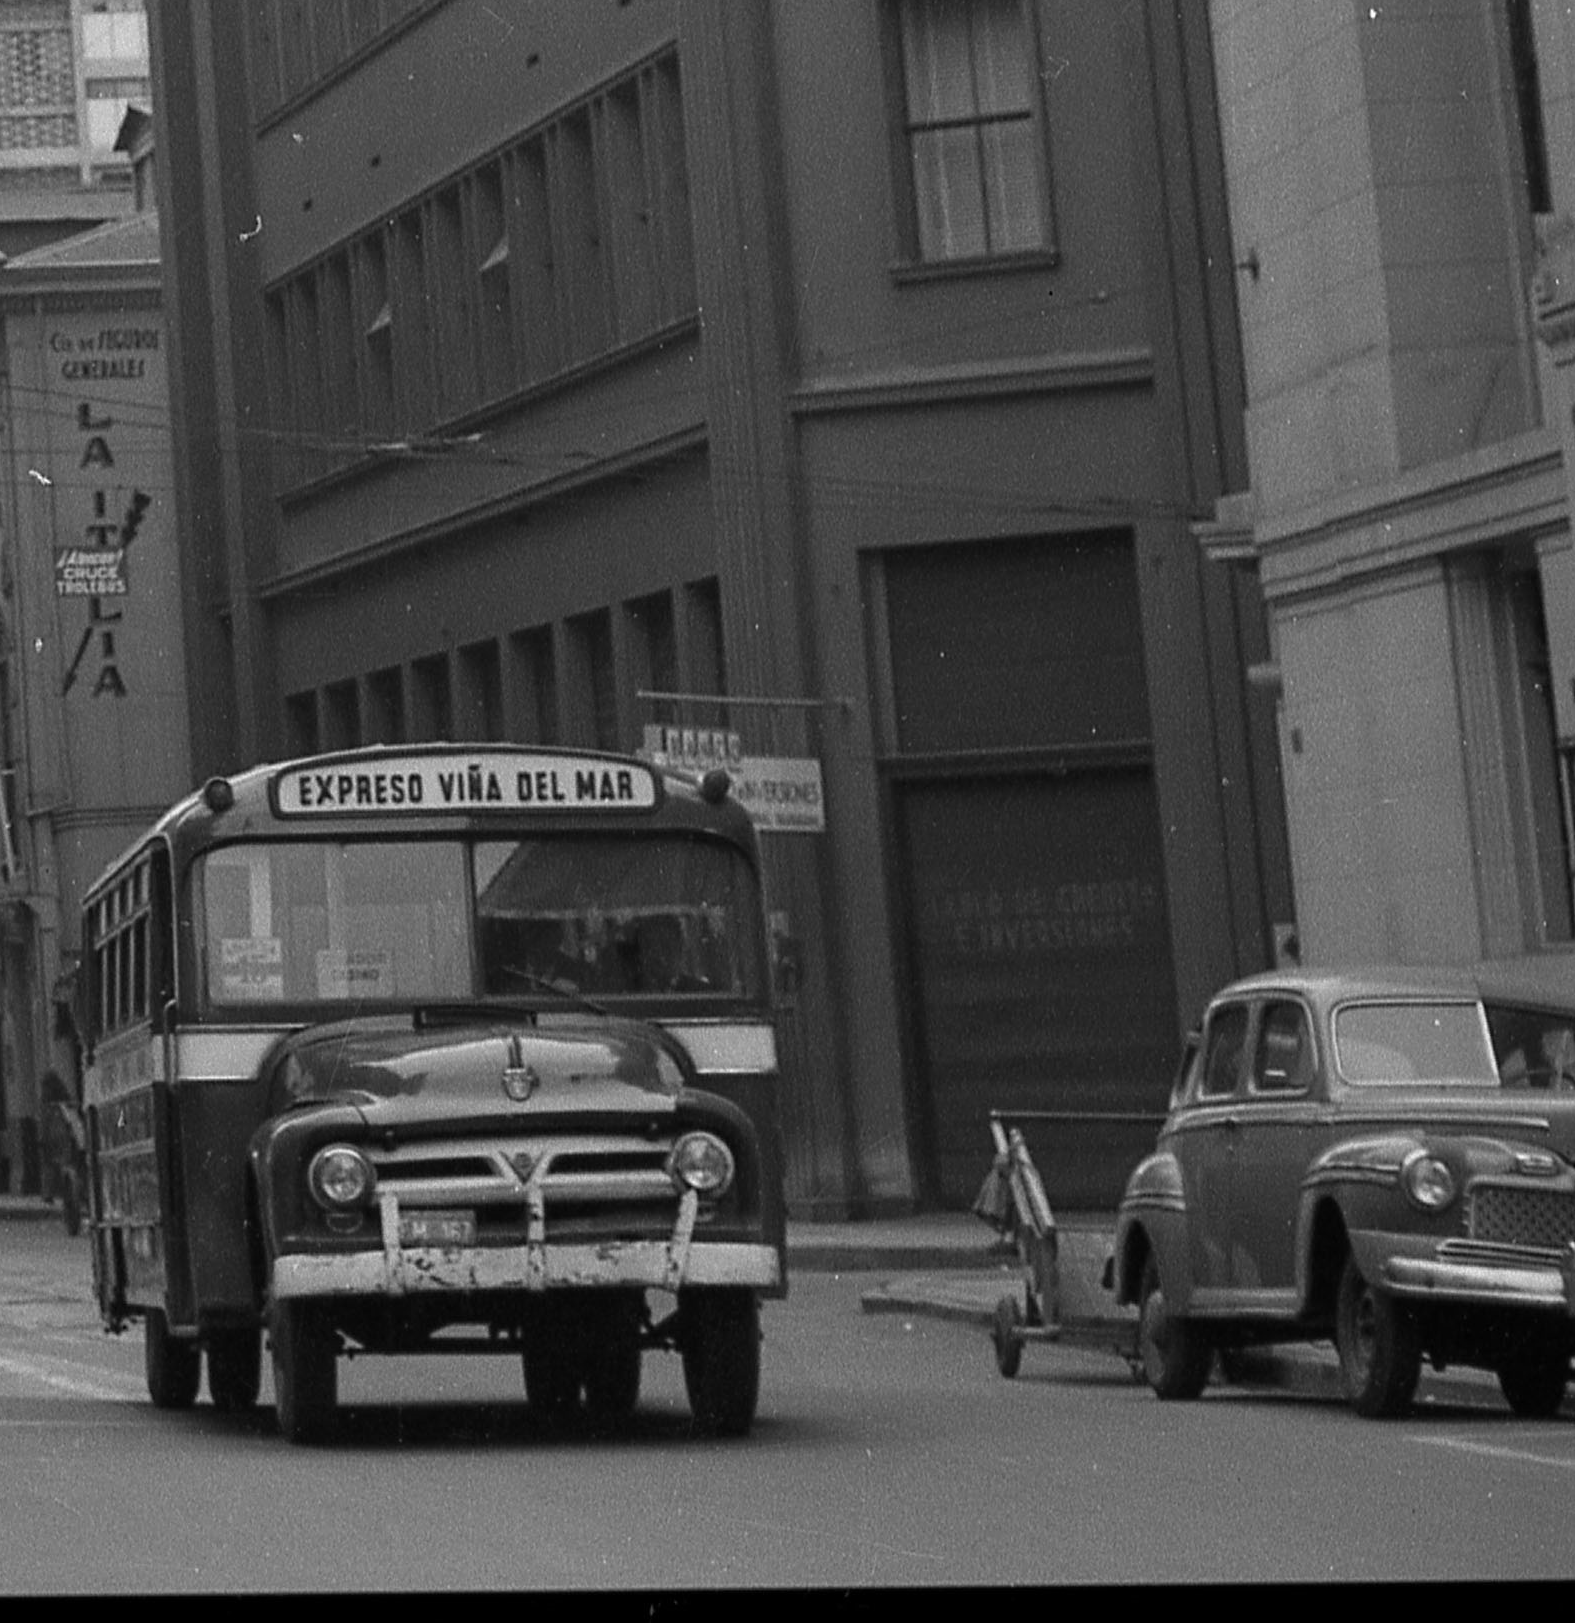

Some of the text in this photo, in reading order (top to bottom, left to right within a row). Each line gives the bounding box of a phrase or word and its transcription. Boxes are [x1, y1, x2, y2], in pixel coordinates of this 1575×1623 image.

[62, 359, 145, 380] GENERALES
[78, 403, 114, 468] LA
[86, 491, 126, 697] ITLIA
[299, 764, 634, 805] EXPRESO VIÑA DEL MAR
